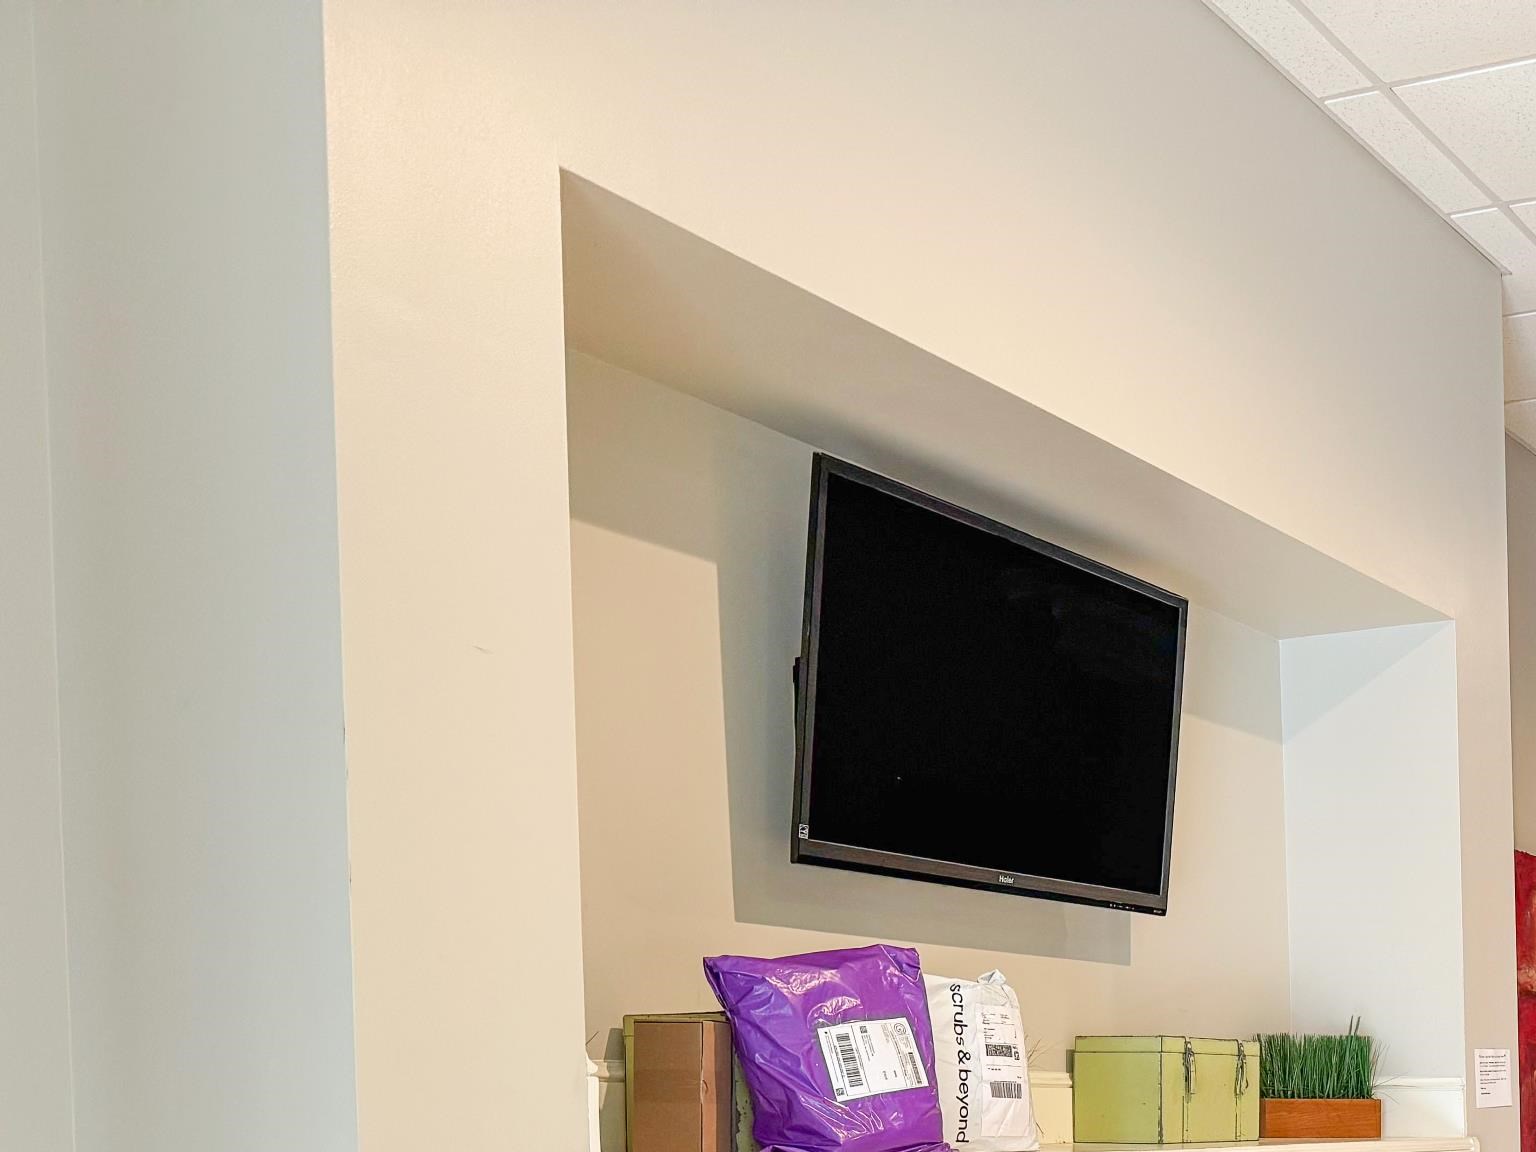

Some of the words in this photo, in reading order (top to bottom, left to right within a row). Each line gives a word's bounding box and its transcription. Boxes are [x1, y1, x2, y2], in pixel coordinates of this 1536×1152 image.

[949, 983, 968, 1047] scrubs
[957, 1050, 971, 1065] &
[955, 1069, 972, 1143] beyond
